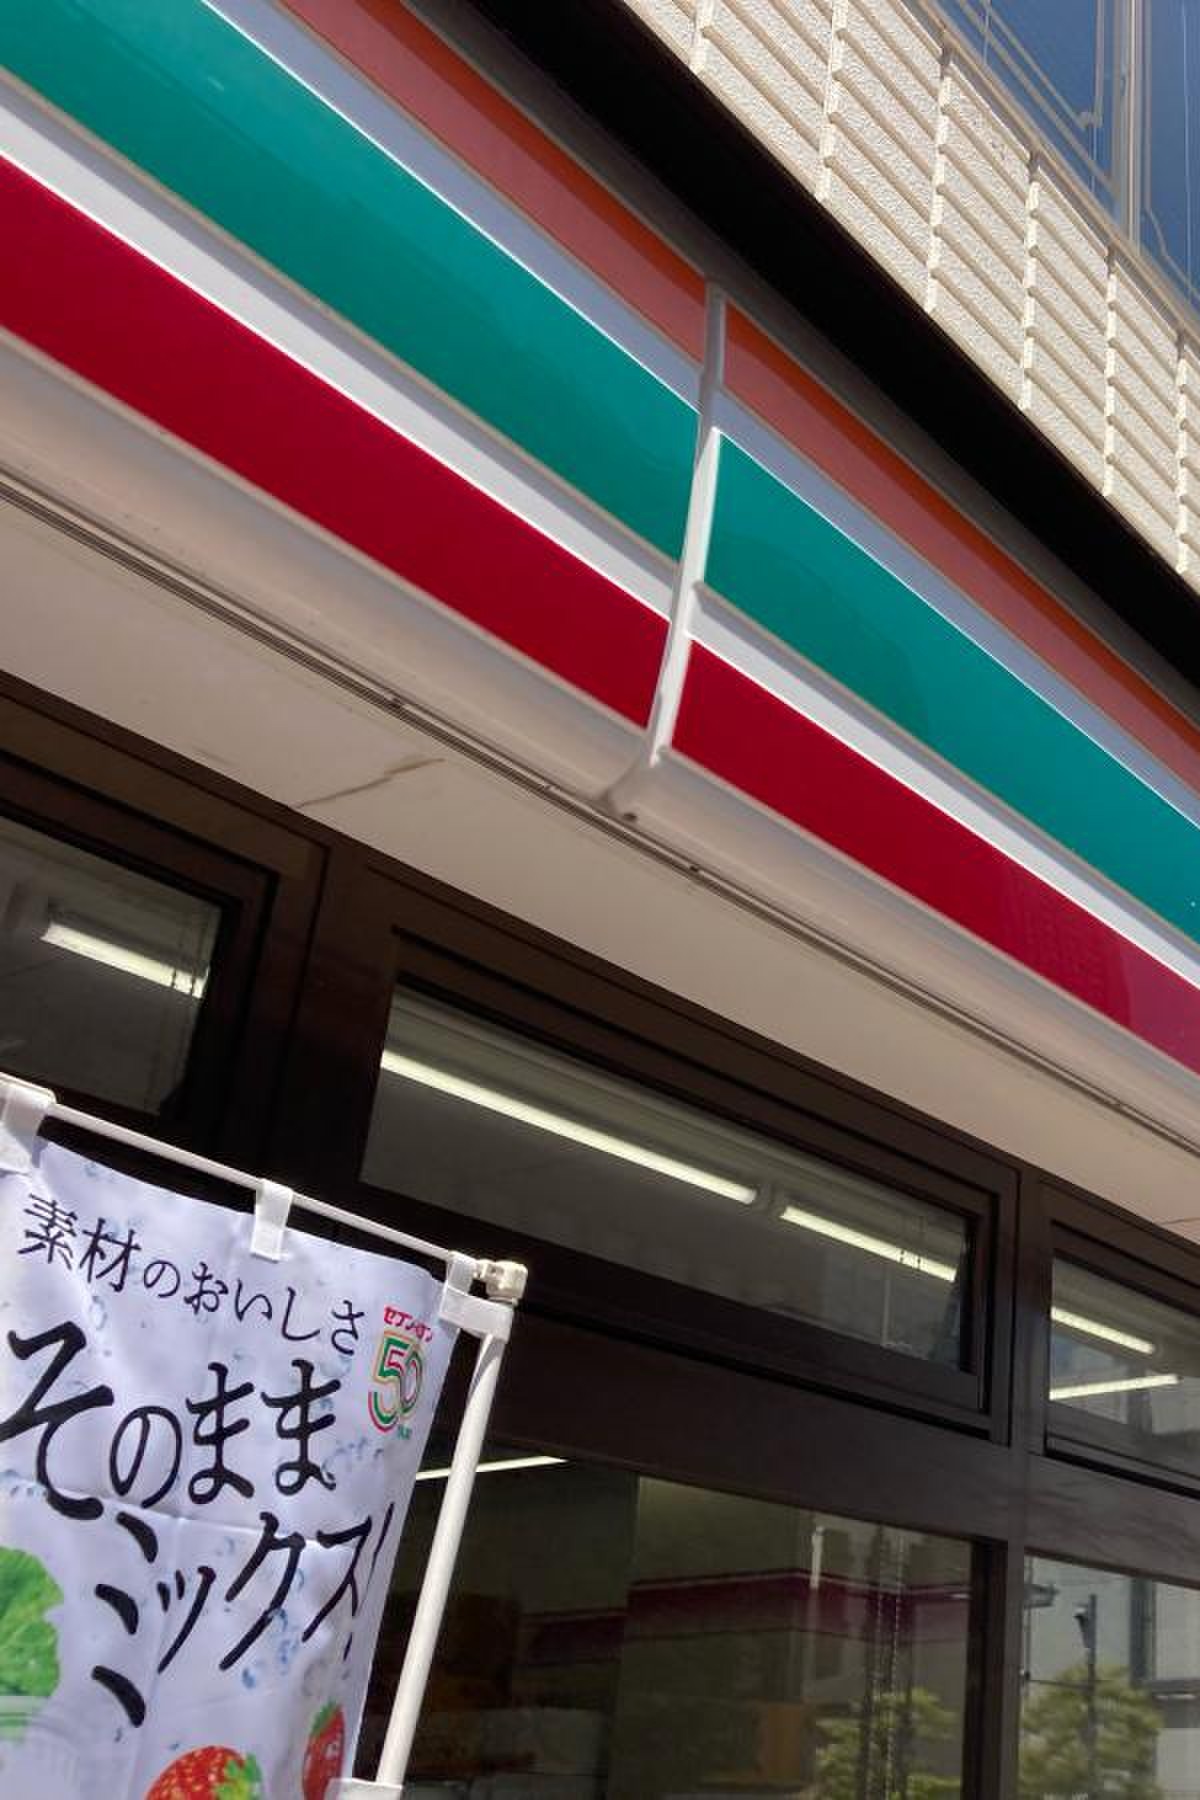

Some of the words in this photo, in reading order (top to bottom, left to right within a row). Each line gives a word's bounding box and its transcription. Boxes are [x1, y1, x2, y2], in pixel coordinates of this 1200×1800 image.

[17, 1193, 365, 1356] 素材のおいしさ
[0, 1321, 343, 1520] そのまま
